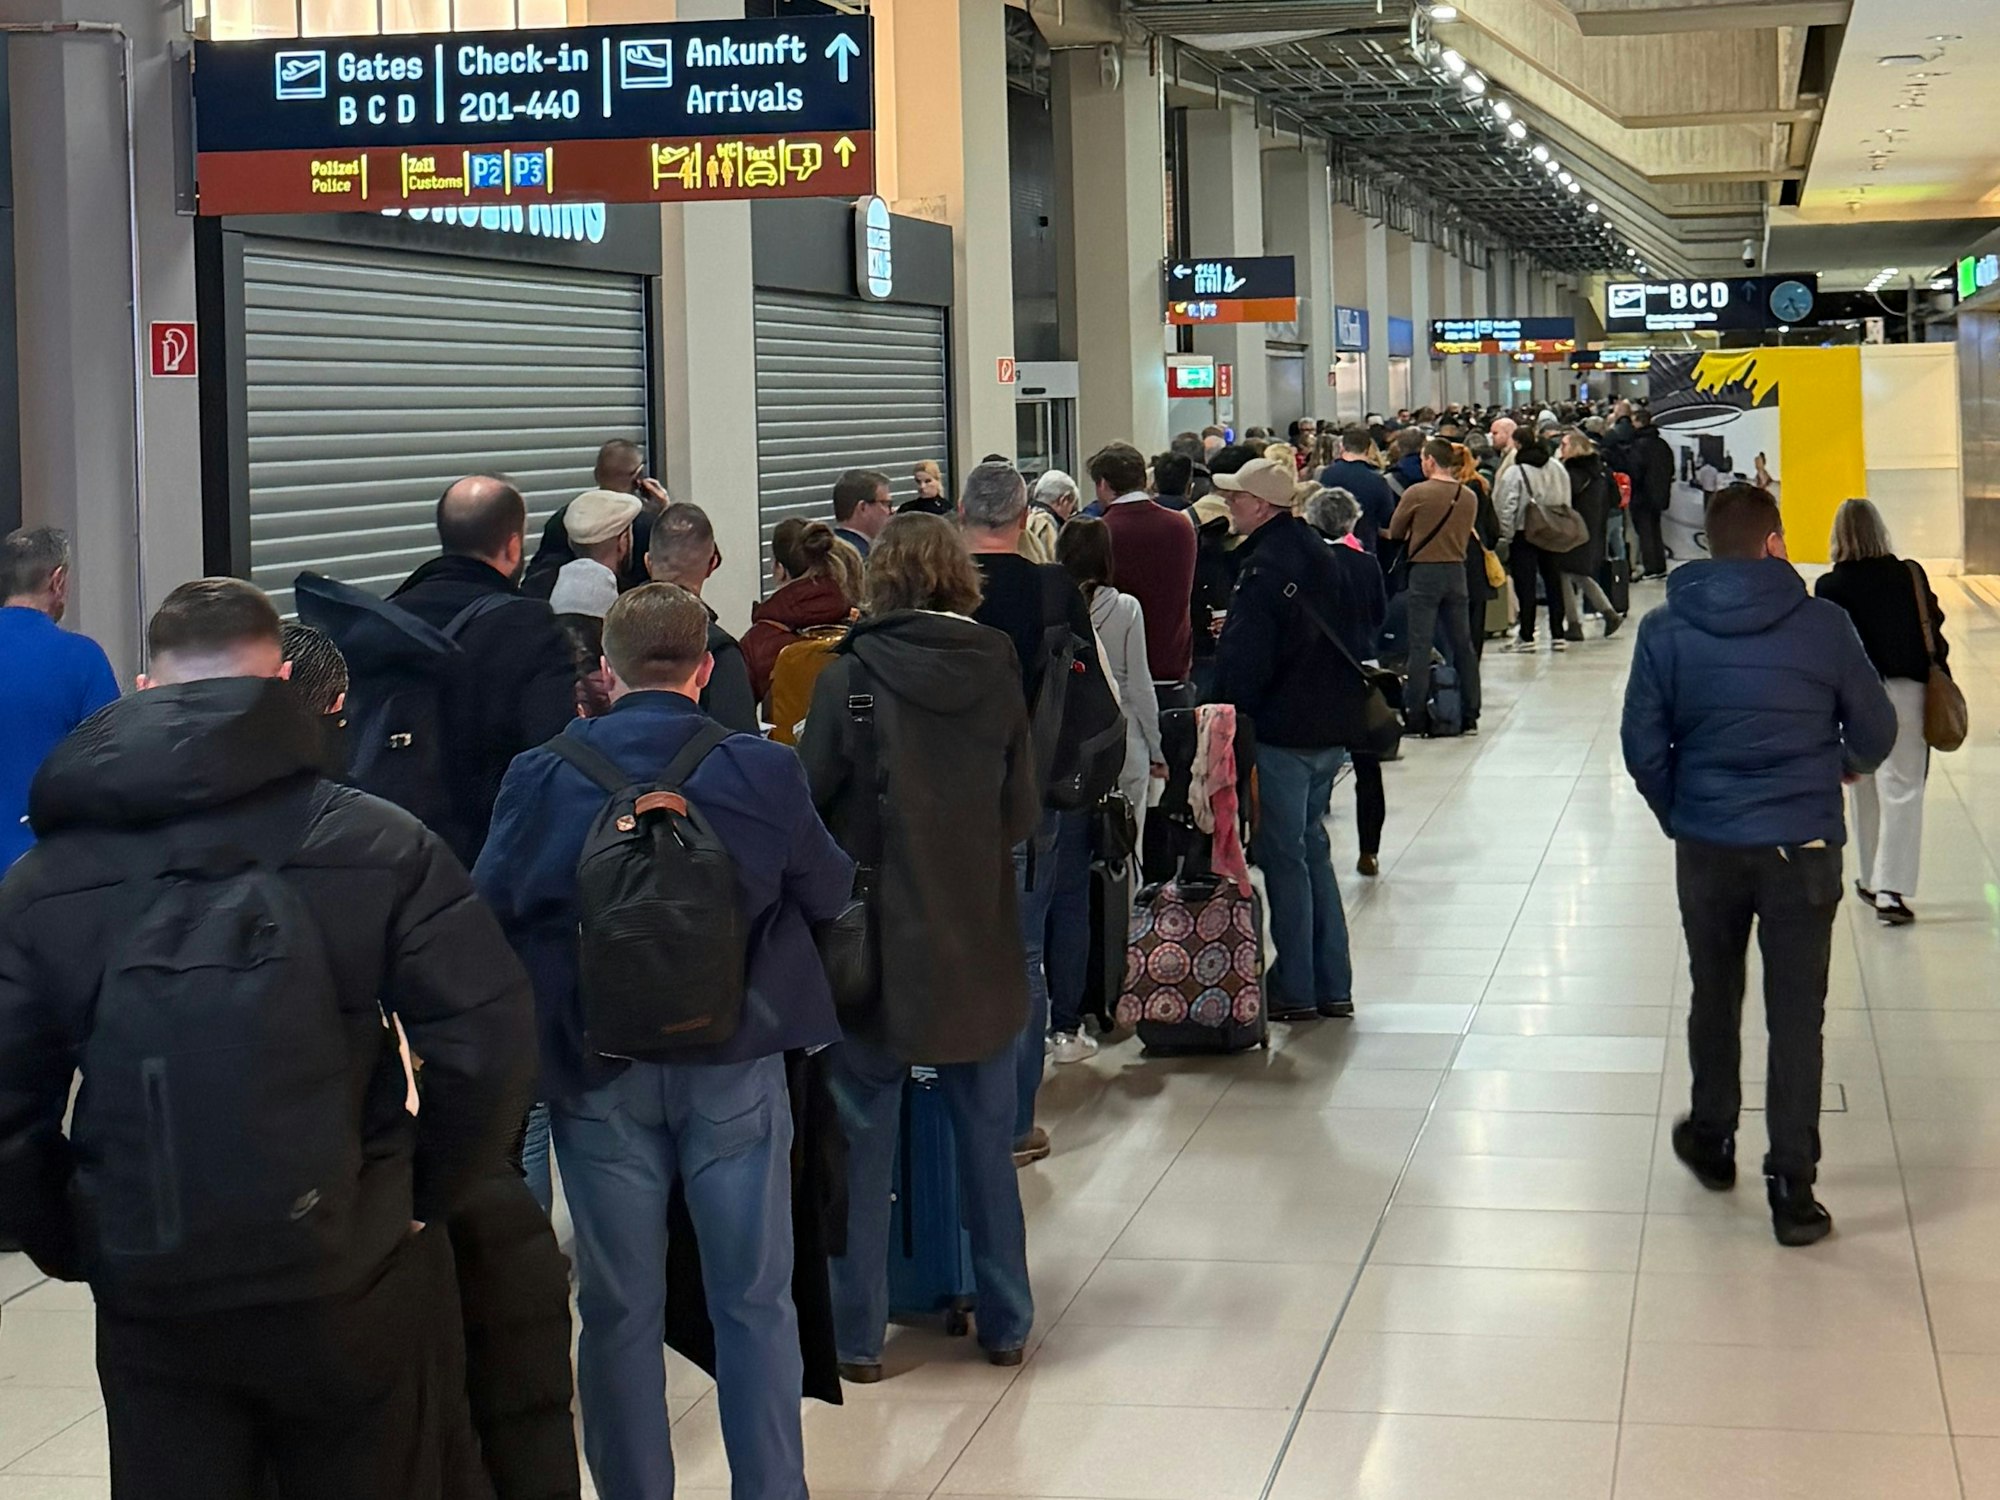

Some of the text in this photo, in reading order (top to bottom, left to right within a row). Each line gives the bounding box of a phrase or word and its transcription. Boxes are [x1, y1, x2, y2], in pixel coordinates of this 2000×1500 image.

[458, 43, 589, 76] Check-in
[686, 34, 808, 67] Ankunft
[338, 52, 423, 82] Gates
[339, 94, 416, 125] B C D
[459, 89, 580, 123] 201-440
[687, 82, 803, 114] Arrivals
[716, 142, 738, 158] WC
[745, 146, 776, 161] Taxi
[311, 160, 360, 177] Polizei
[408, 157, 436, 173] Zoll
[312, 179, 351, 193] Police
[408, 176, 464, 190] Customs
[1669, 281, 1729, 309] BCD
